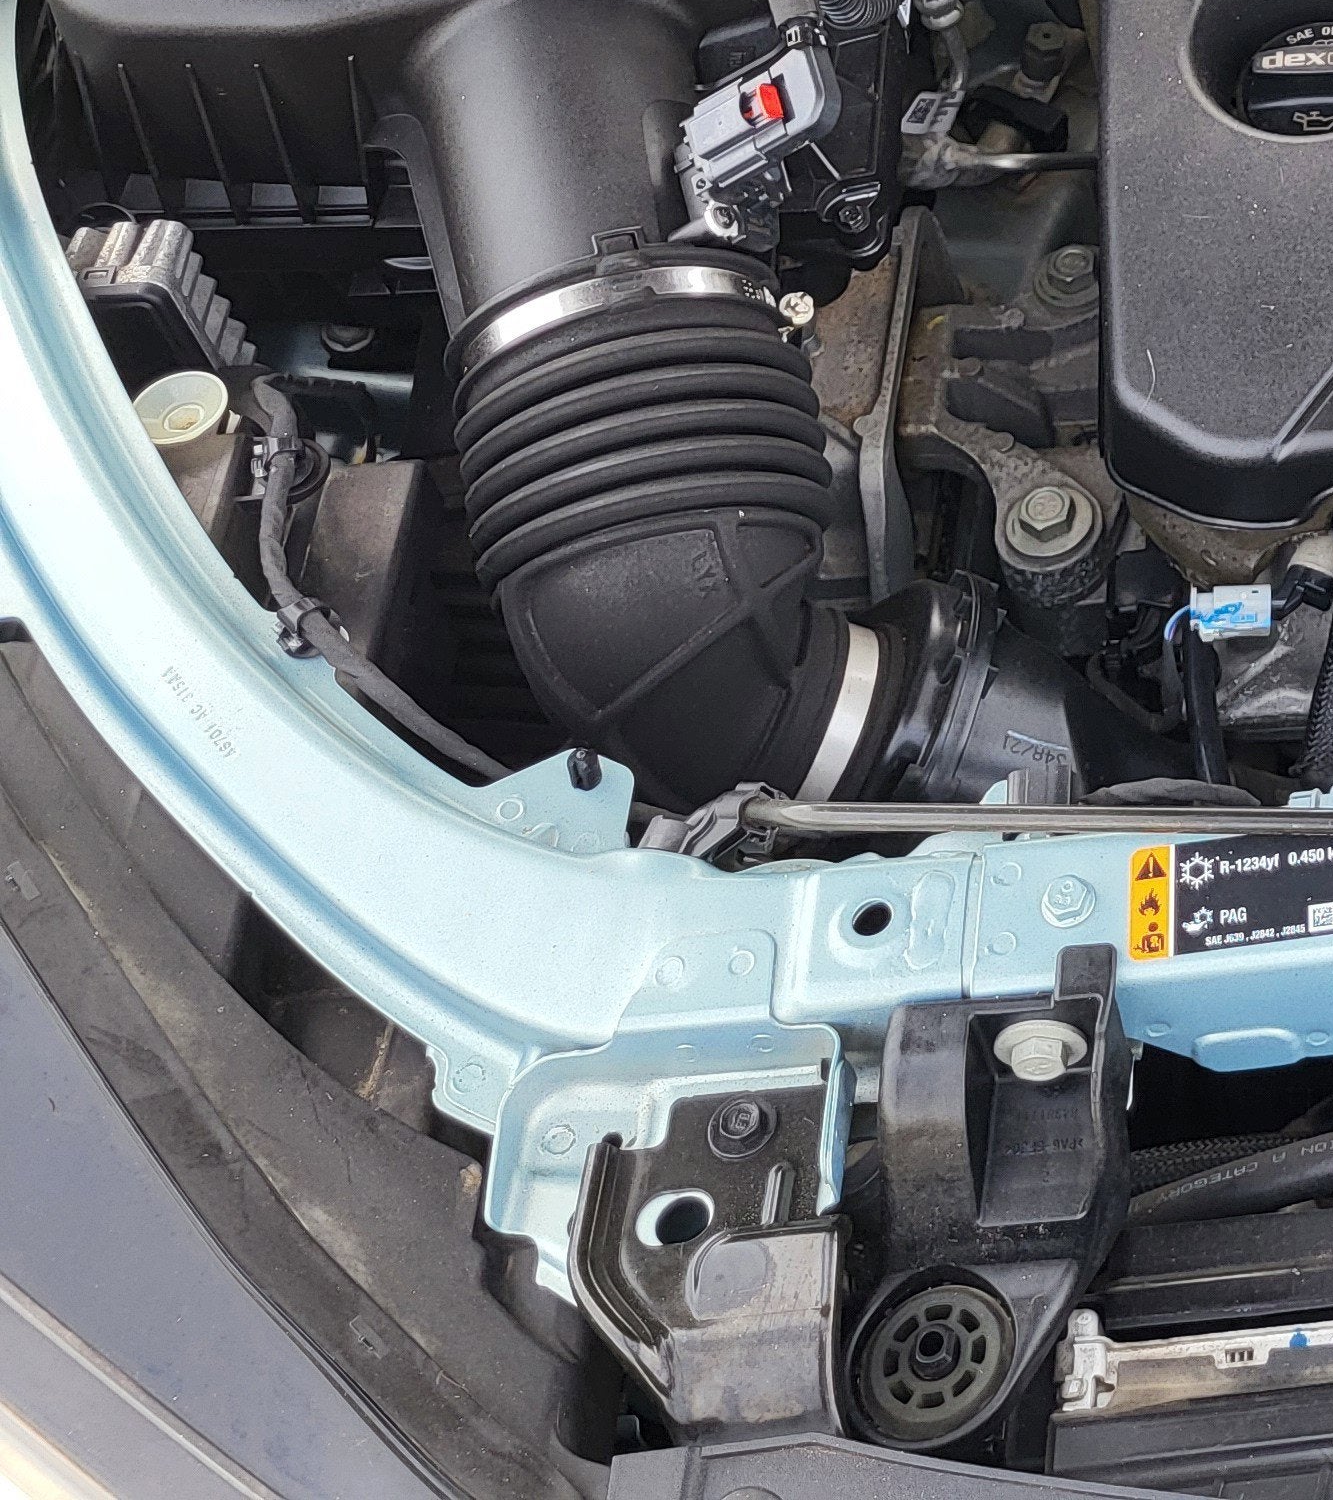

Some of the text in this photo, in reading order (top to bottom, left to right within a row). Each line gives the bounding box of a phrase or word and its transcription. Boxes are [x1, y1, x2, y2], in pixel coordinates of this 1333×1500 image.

[1286, 28, 1314, 44] SAE
[1219, 853, 1281, 875] R-1234yf
[1287, 848, 1325, 866] 0.450
[1219, 907, 1248, 926] PAG
[1205, 934, 1222, 947] SAE
[1272, 1151, 1287, 1164] A
[1157, 1161, 1259, 1202] CATEGORY
